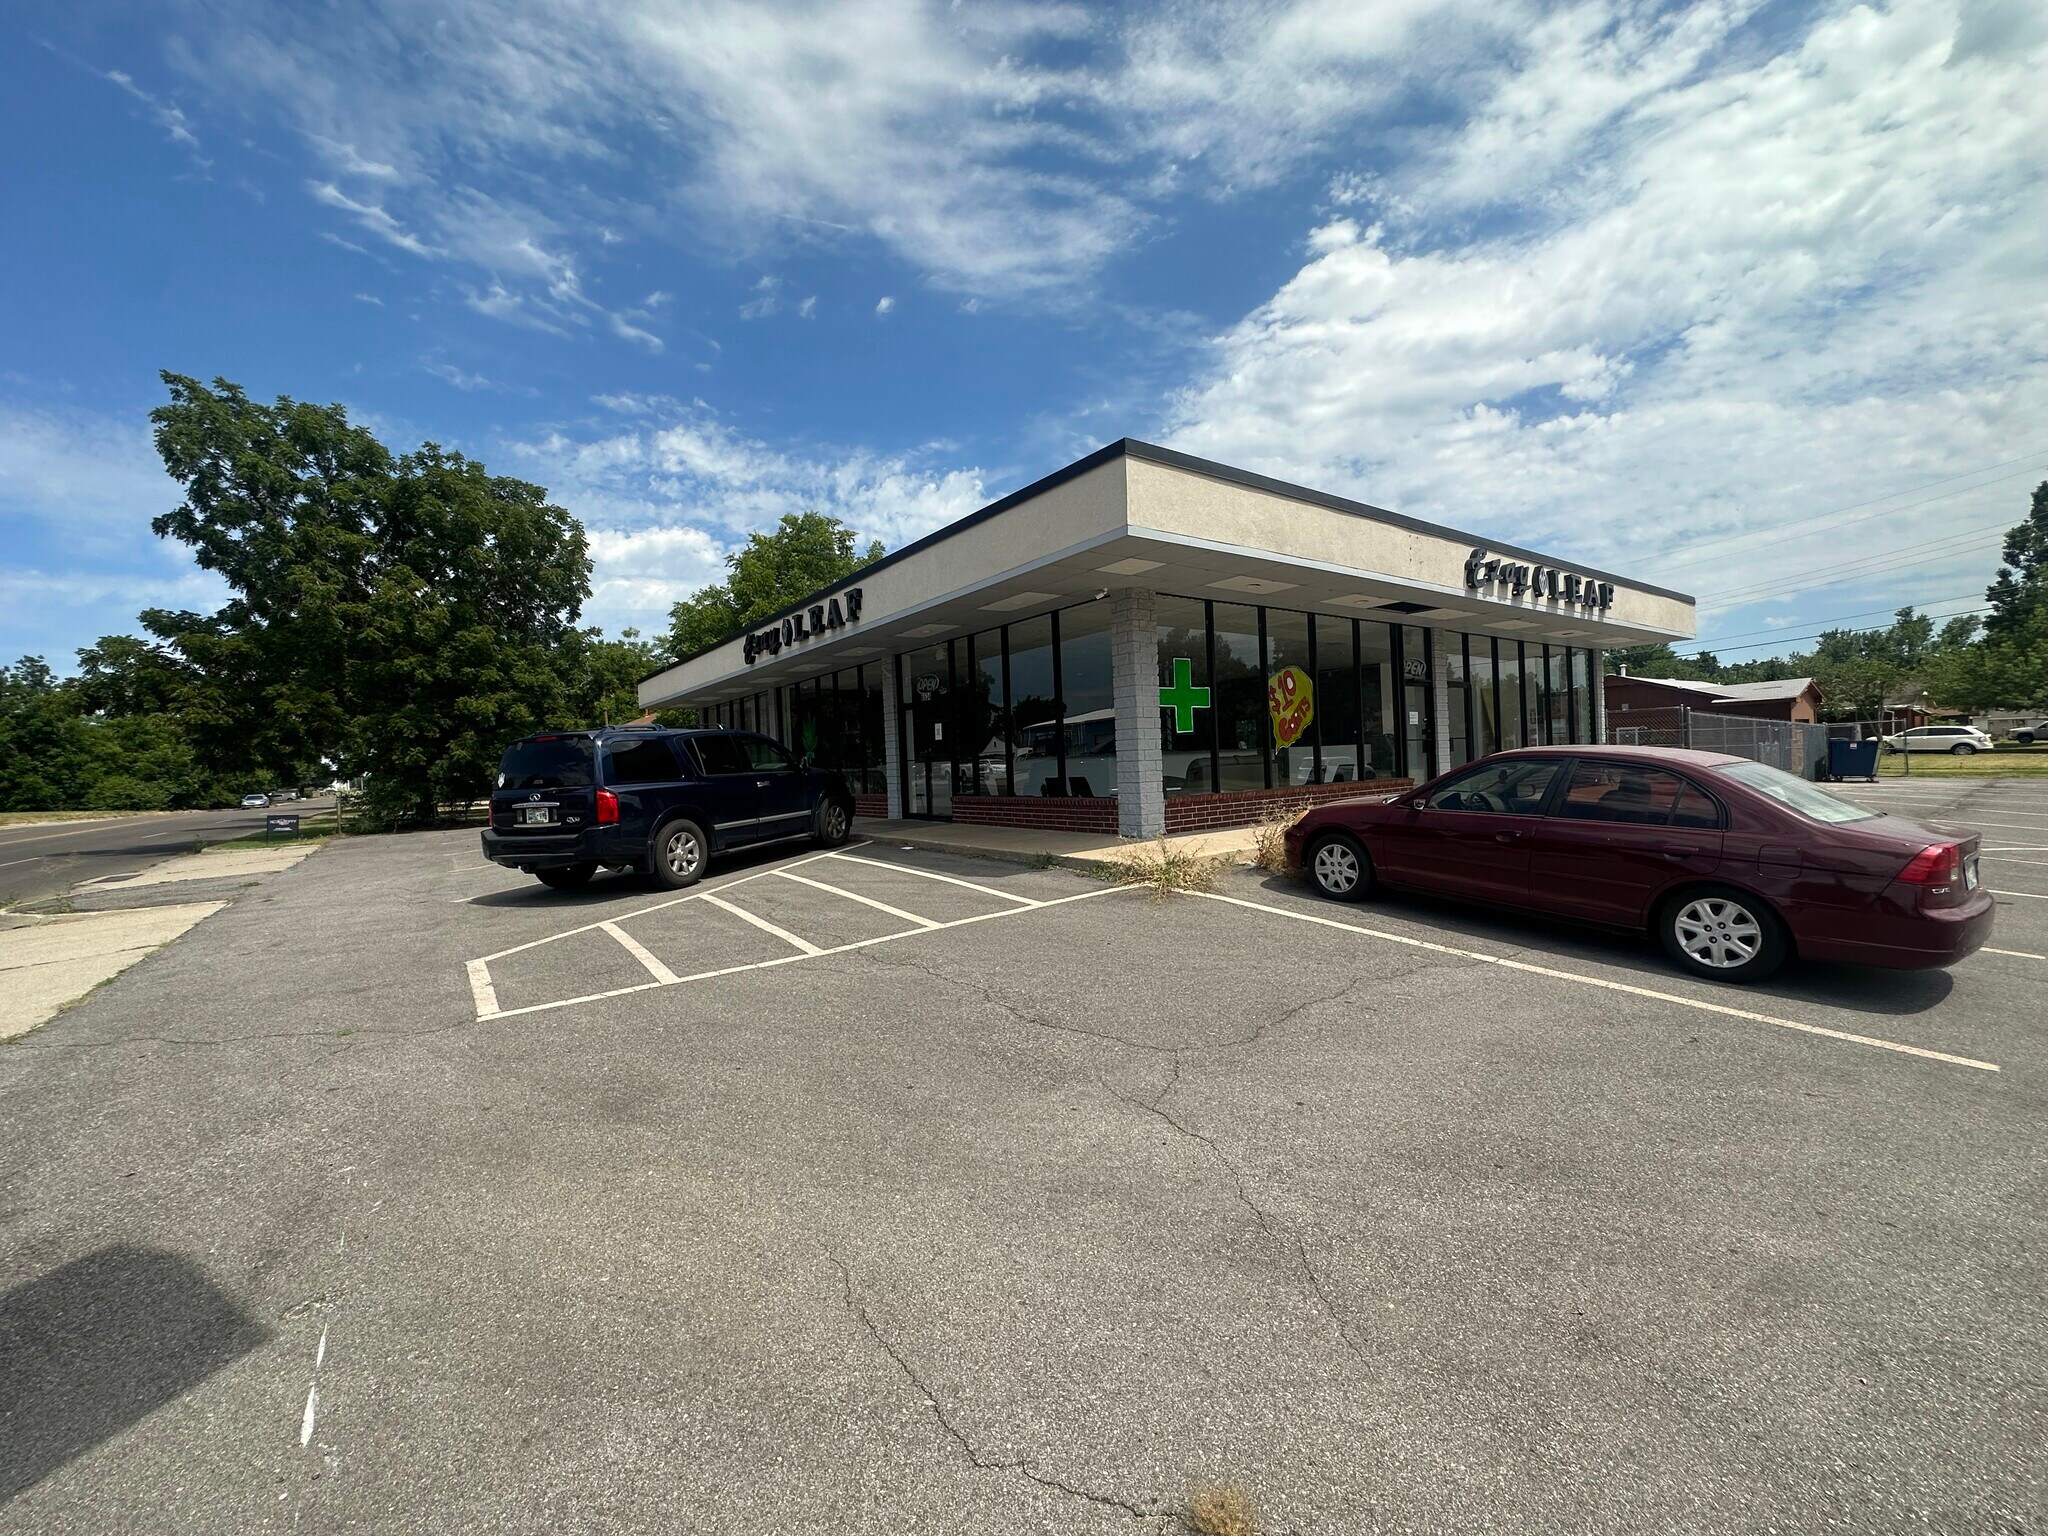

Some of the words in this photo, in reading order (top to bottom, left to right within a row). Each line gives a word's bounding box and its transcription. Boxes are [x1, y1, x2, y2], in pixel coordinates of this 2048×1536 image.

[1548, 569, 1614, 609] LEAF
[791, 588, 863, 642] LEAF
[919, 678, 938, 691] OPEN
[1404, 660, 1424, 676] PEN
[1269, 670, 1297, 715] $10
